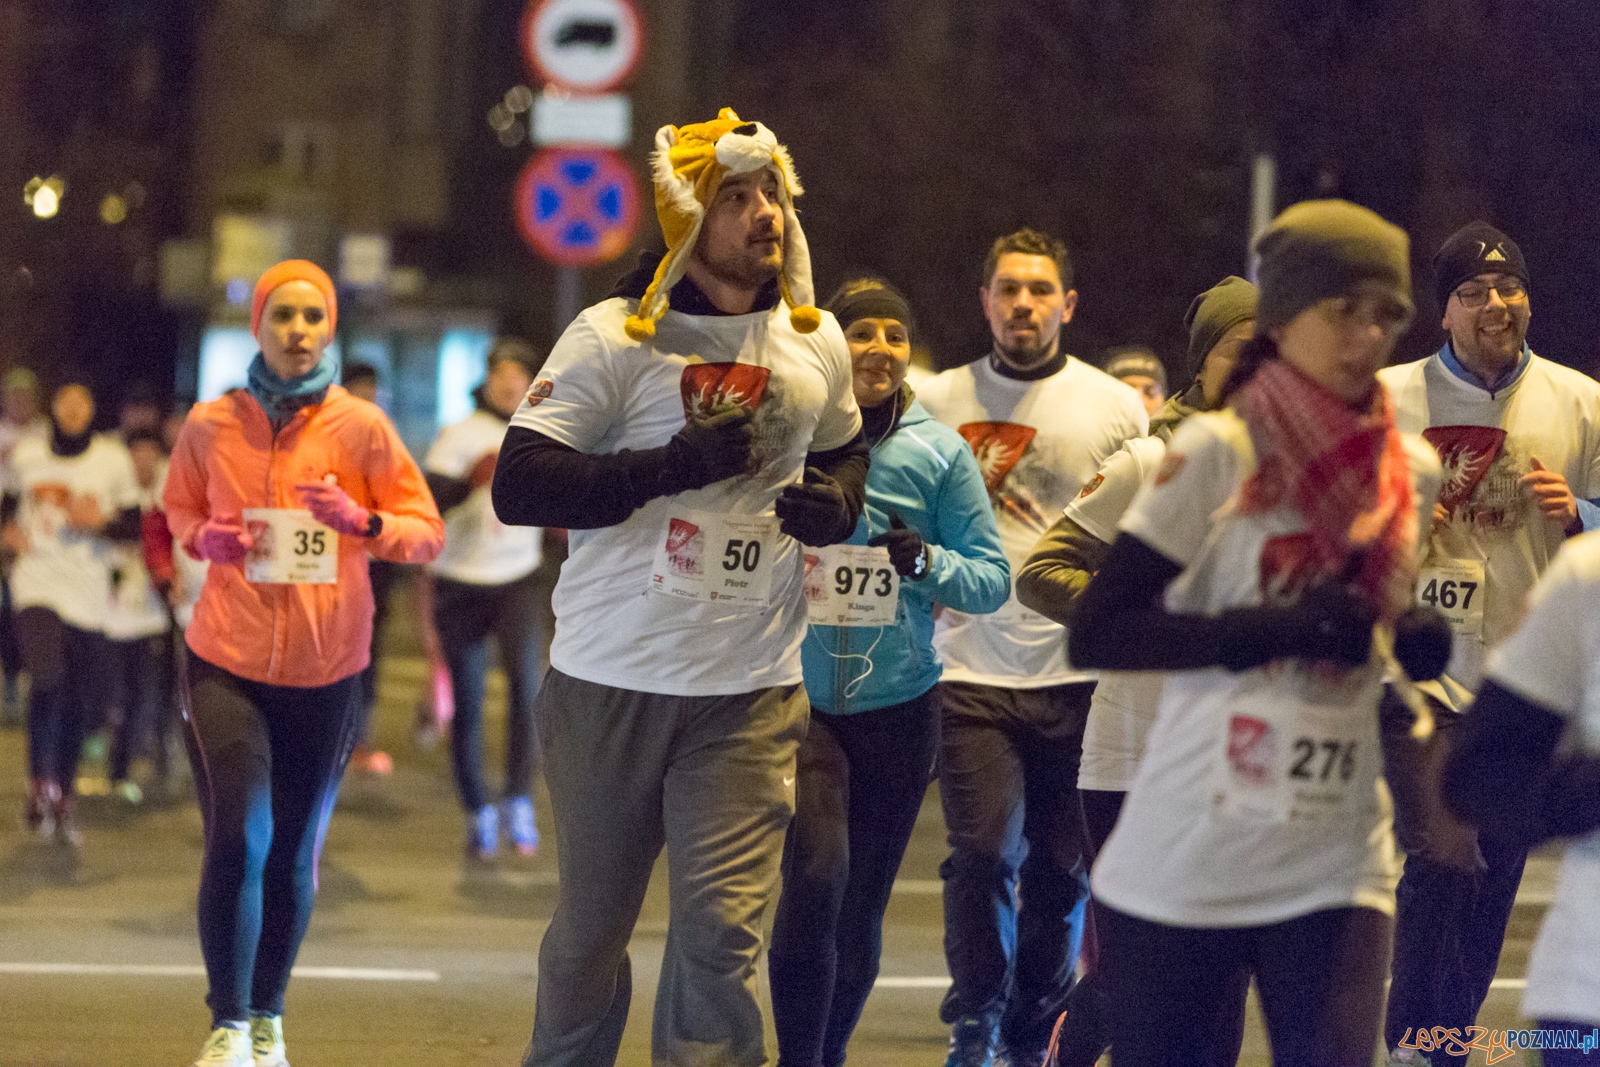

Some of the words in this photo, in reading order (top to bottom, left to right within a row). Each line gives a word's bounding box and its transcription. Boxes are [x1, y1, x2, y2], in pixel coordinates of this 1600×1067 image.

[294, 529, 326, 556] 35
[722, 538, 761, 572] 50
[834, 565, 893, 597] 973
[1421, 578, 1478, 610] 467
